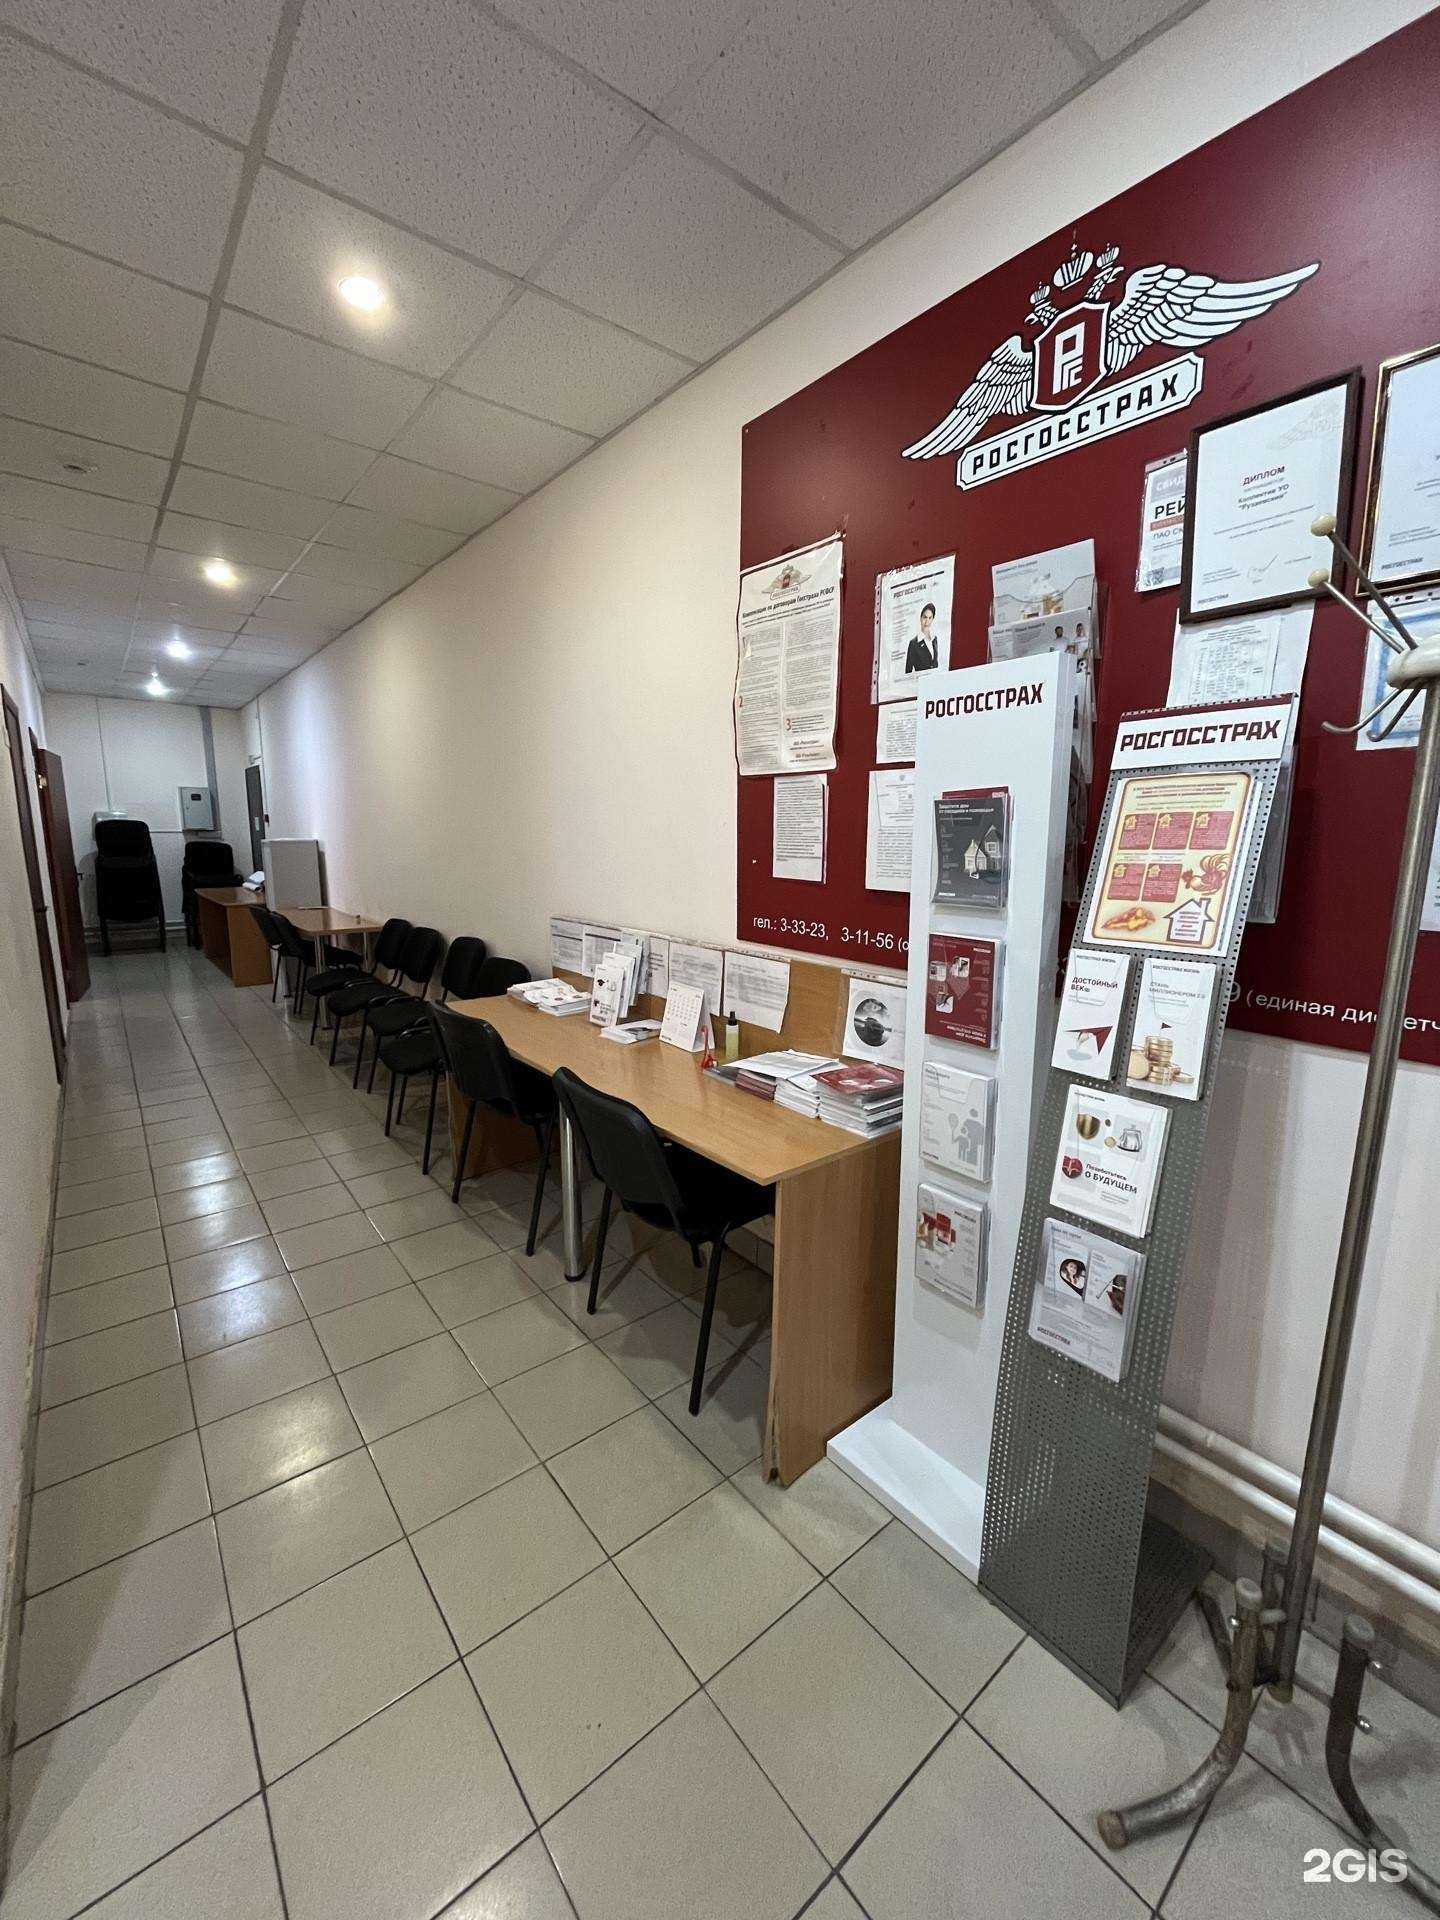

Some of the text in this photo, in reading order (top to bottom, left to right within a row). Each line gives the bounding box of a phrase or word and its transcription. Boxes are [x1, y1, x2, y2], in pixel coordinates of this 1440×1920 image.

[972, 373, 1178, 475] РОСГОССТРАХ
[1242, 466, 1285, 486] ДИПЛОМ
[925, 683, 1044, 719] РОСГОССТРАХ
[1120, 719, 1281, 752] РОСГОССТРАХ
[780, 917, 829, 940] 3-33-23,
[841, 926, 894, 949] 3-11-56
[1072, 976, 1118, 989] ДОСТОЙНЫЙ
[1246, 989, 1335, 1017] (единая
[1085, 1170, 1138, 1194] О БУДУЩЕМ
